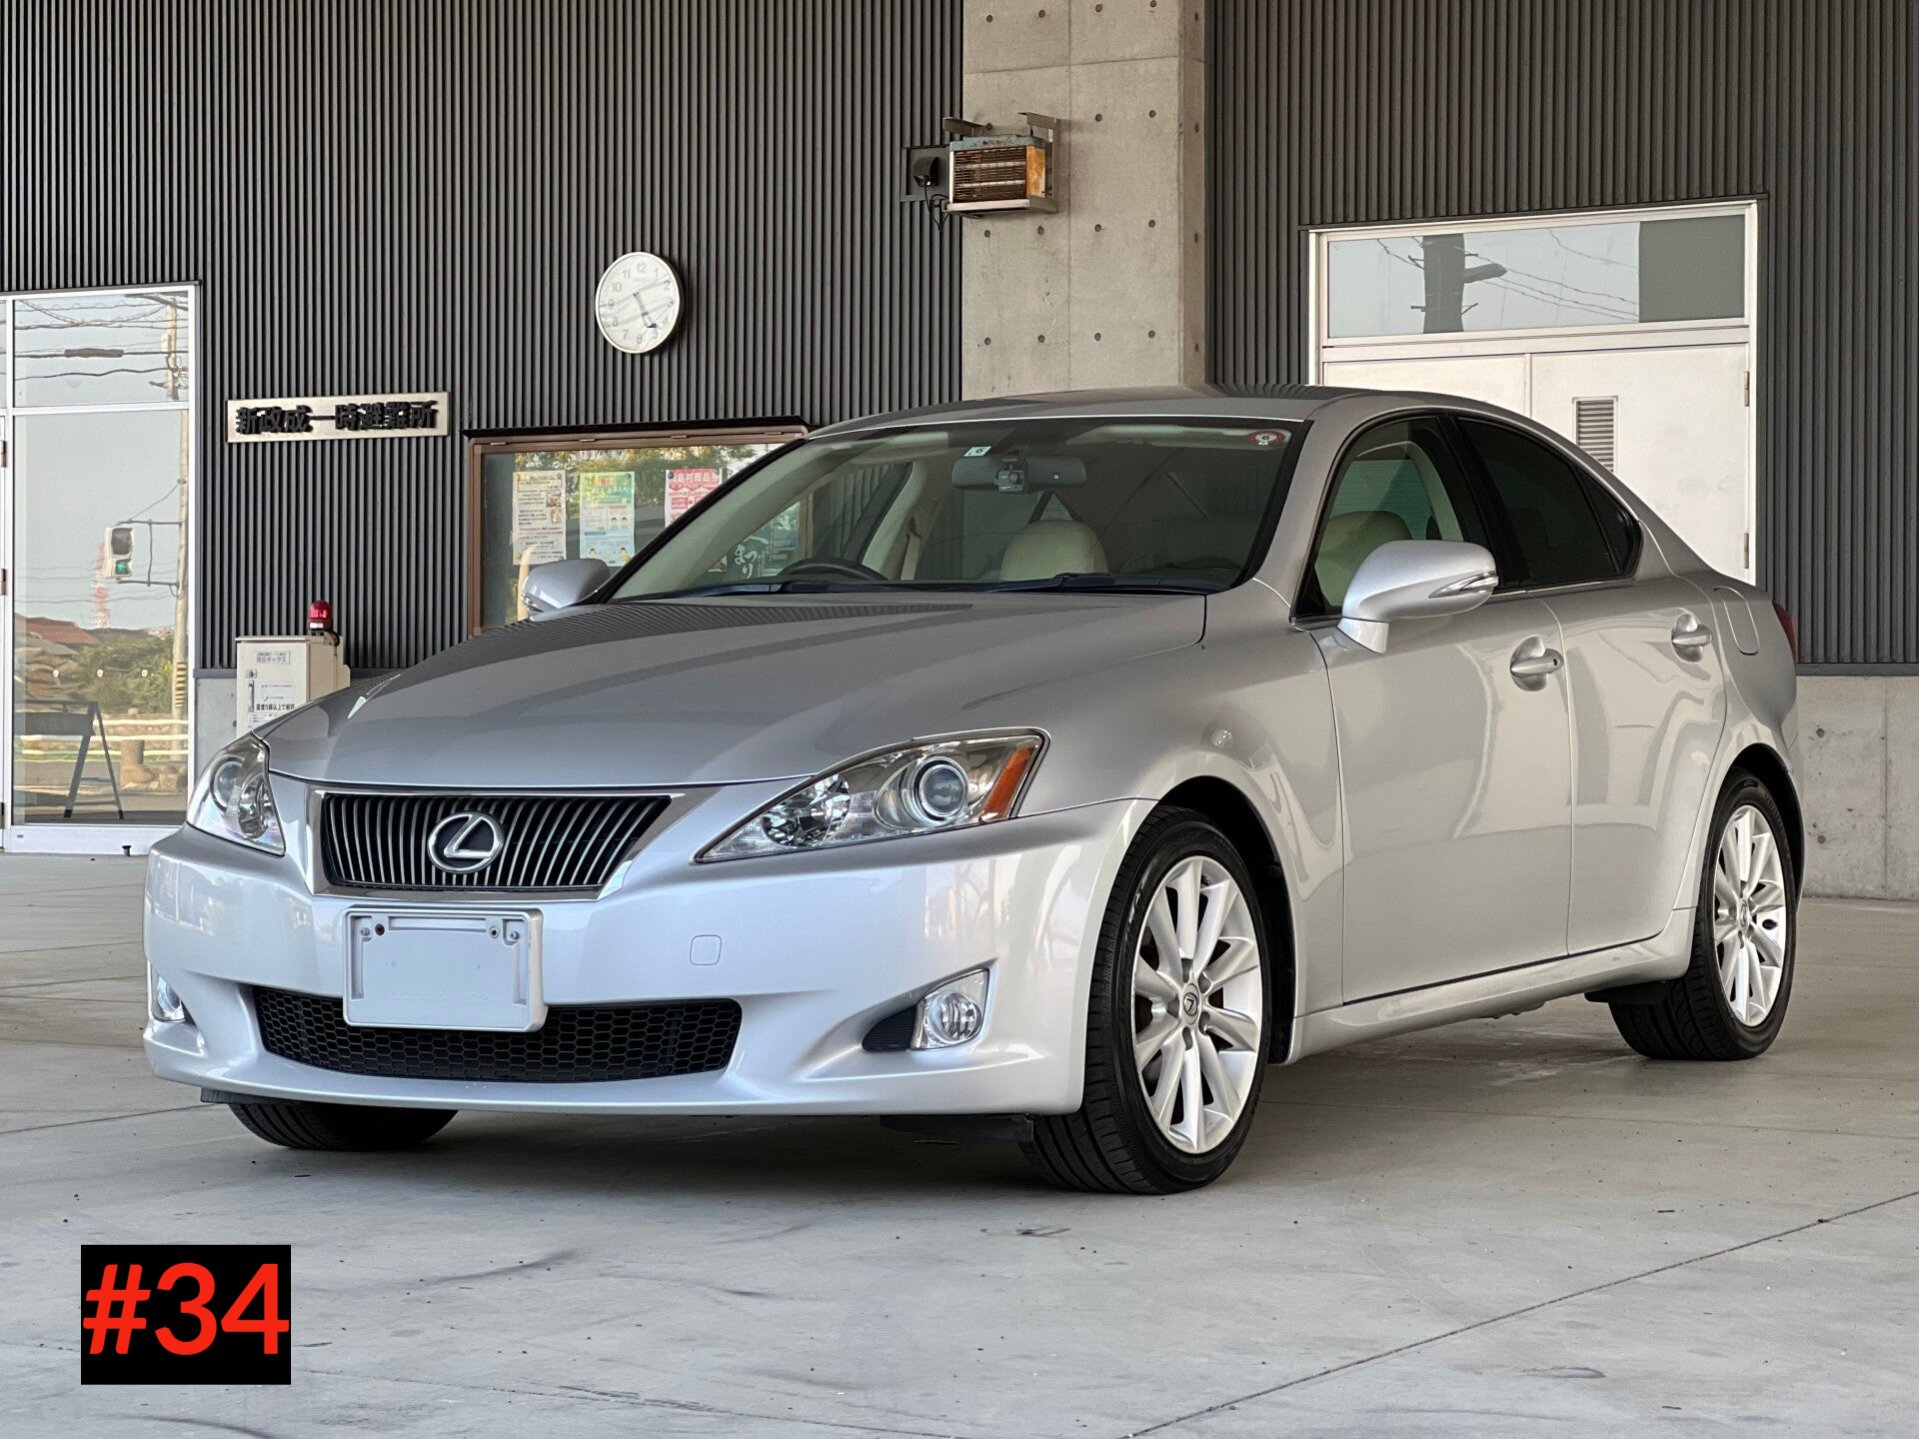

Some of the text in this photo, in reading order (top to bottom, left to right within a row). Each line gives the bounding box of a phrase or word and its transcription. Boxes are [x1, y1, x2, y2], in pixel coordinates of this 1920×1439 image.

[637, 263, 646, 273] 12
[654, 267, 659, 278] 1
[622, 269, 631, 279] 11
[612, 281, 622, 292] 10
[663, 280, 671, 290] 2
[608, 298, 615, 309] 9
[612, 316, 619, 327] 8
[623, 329, 628, 340] 7
[637, 334, 643, 344] 6
[236, 400, 439, 434] 新政成一時避難所
